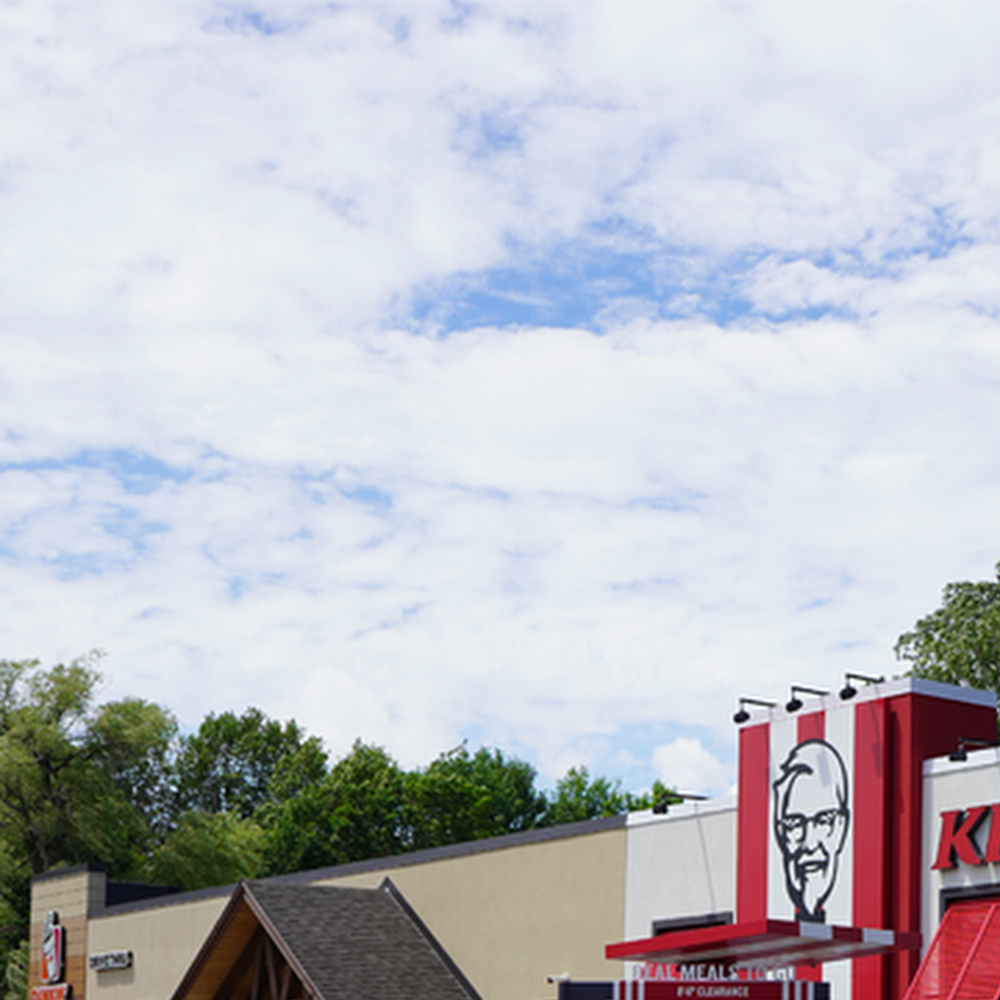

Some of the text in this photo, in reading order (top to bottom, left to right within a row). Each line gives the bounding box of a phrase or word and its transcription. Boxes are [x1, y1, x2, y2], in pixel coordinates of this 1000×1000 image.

[632, 962, 678, 981] REAL
[679, 961, 740, 981] MEALS
[696, 985, 750, 998] CLEARANCE
